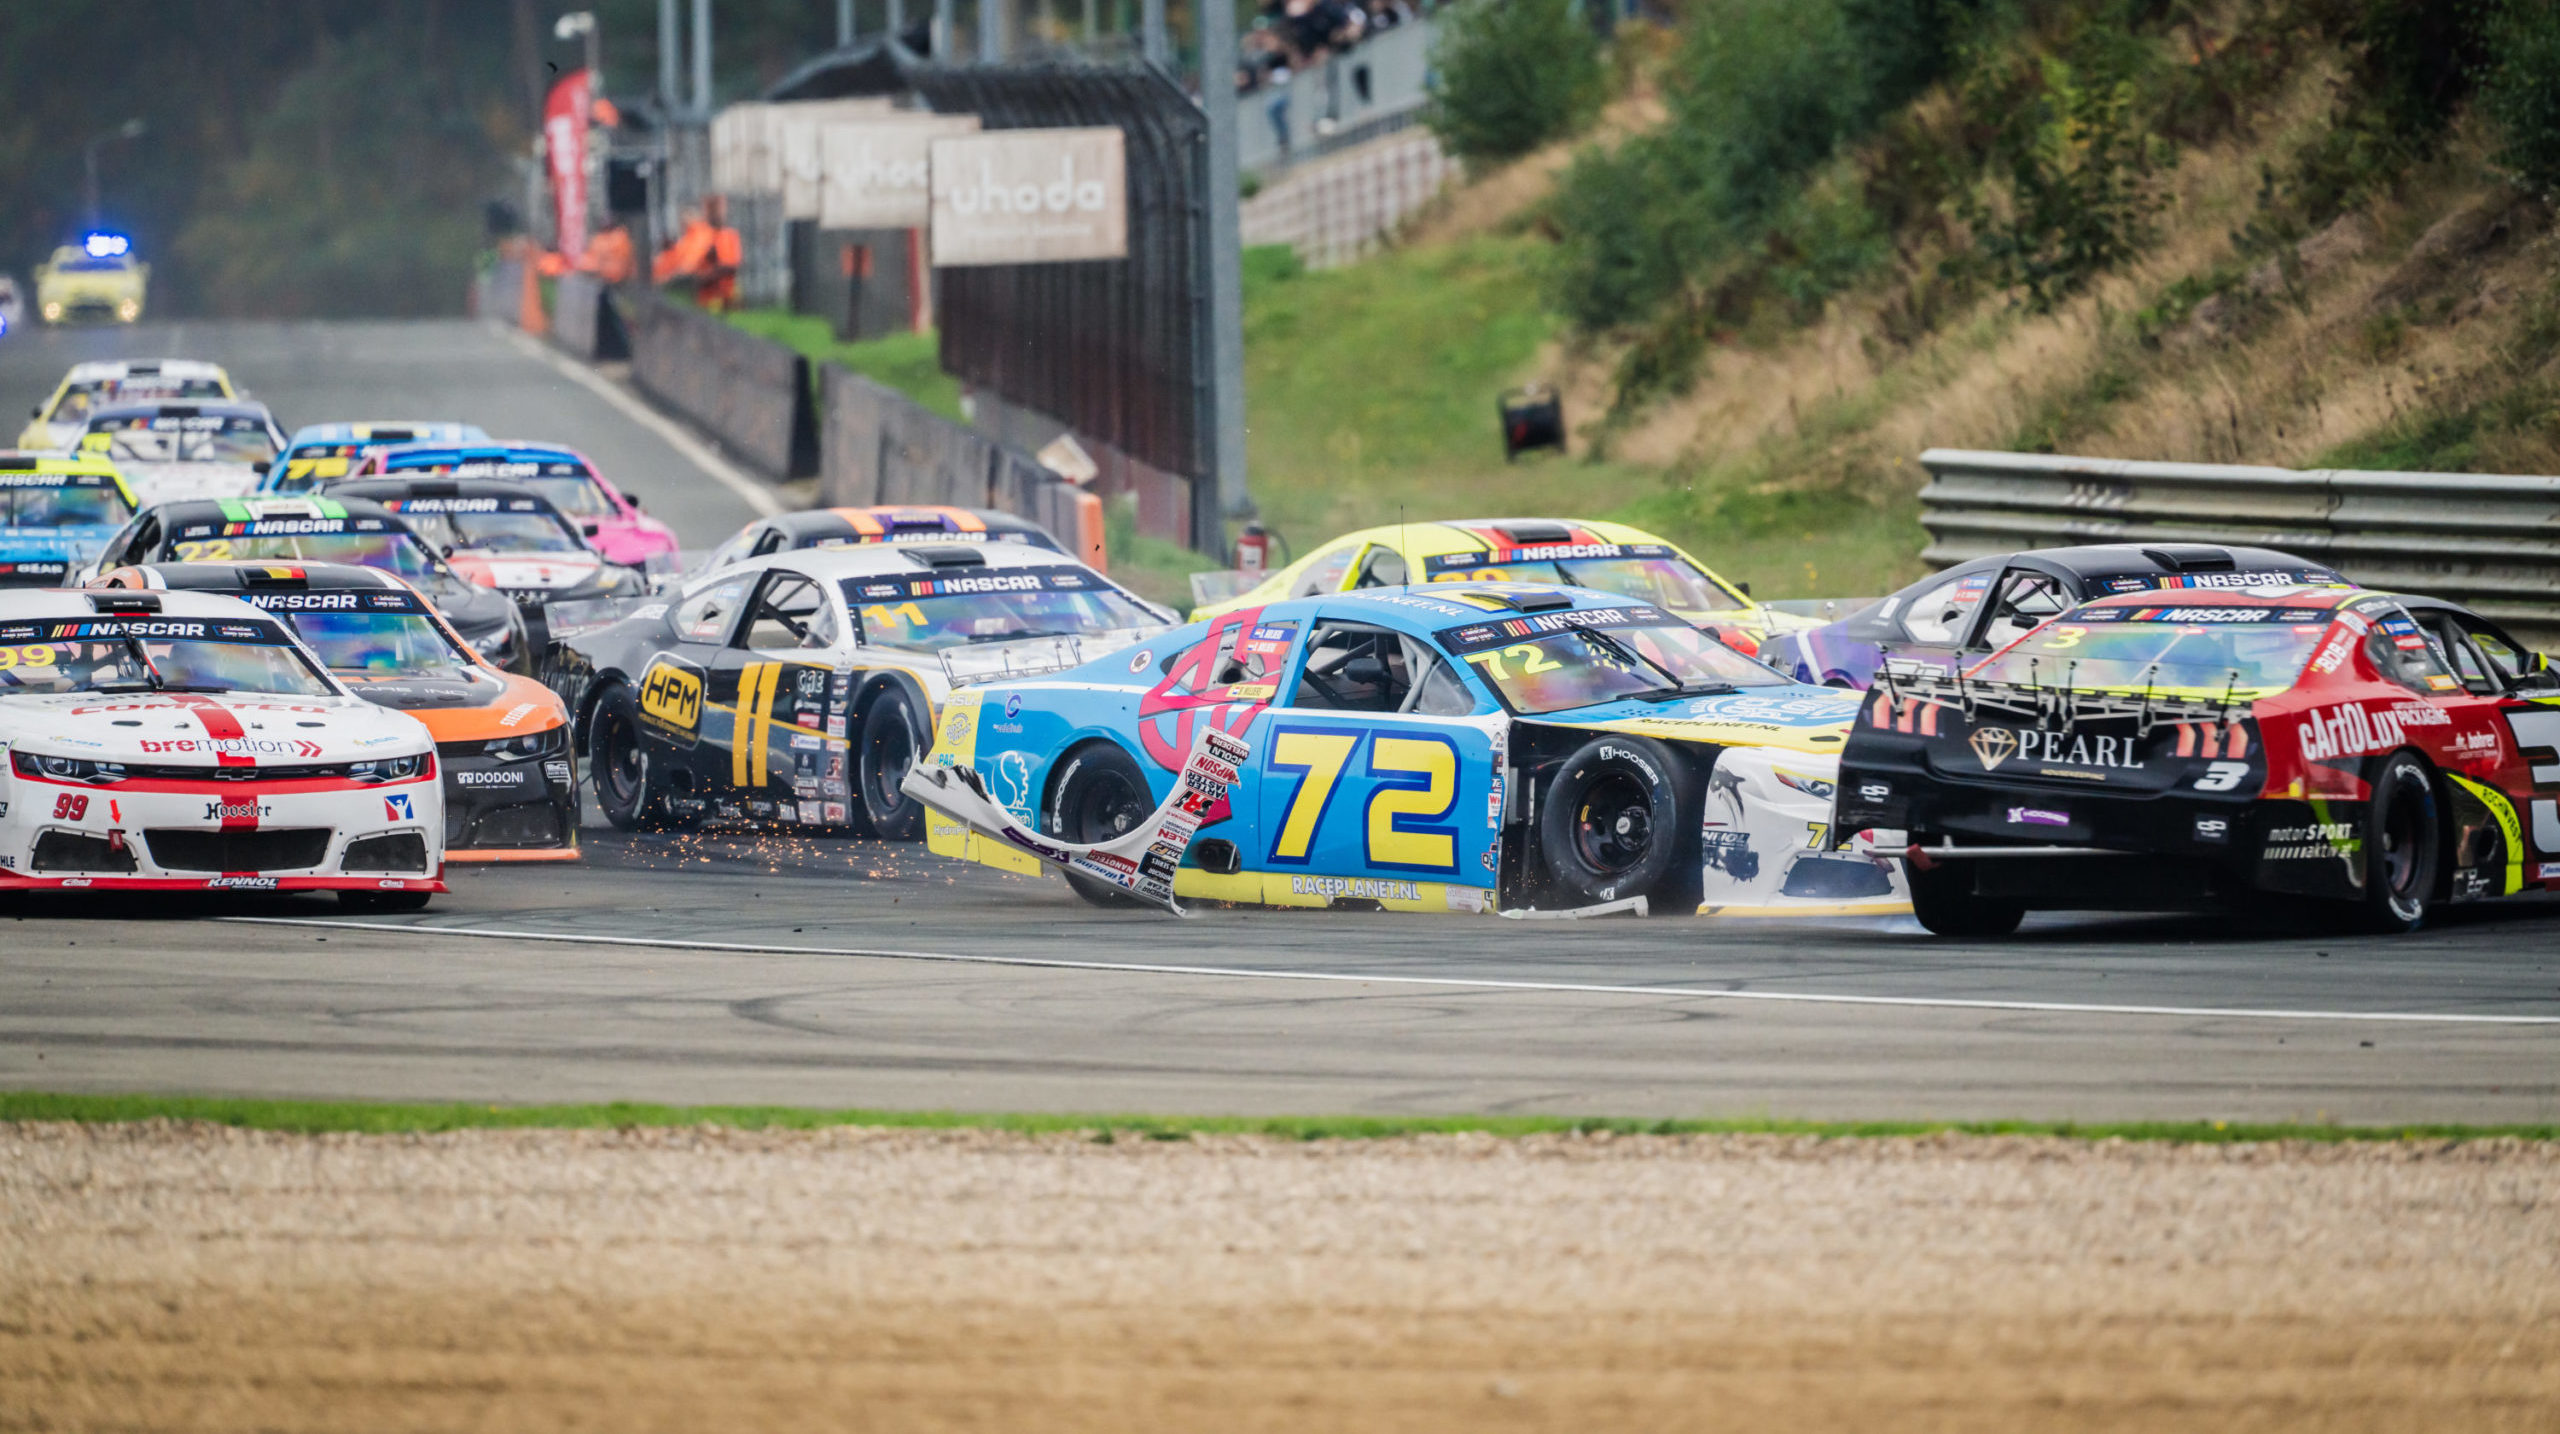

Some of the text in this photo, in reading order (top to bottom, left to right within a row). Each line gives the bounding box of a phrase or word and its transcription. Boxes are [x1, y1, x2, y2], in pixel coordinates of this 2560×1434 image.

[834, 138, 928, 188] uho
[950, 154, 1105, 214] uhoda
[0, 474, 67, 486] ASCAR
[253, 519, 344, 534] NASCAR
[174, 539, 233, 561] 22
[1523, 544, 1621, 560] NASCAR
[943, 575, 1042, 594] NASCAR
[2194, 573, 2295, 588] NASCAR
[250, 594, 357, 609] NASCAR
[862, 602, 928, 628] 11
[1536, 608, 1629, 631] NASCAR
[2163, 609, 2270, 622] NASCAR
[90, 623, 205, 637] NASCAR
[2043, 626, 2089, 648] 3
[1464, 645, 1563, 681] 72
[646, 671, 698, 720] HPM
[732, 661, 783, 787] 11
[141, 738, 297, 753] bremotion
[2016, 730, 2144, 769] PEARL
[476, 772, 524, 783] DODONI
[1195, 756, 1239, 782] MPSON
[1612, 748, 1660, 786] HOOSIER
[2194, 763, 2250, 791] 3
[53, 793, 89, 821] 99
[203, 801, 272, 820] Hoosier
[1266, 724, 1462, 876] 72
[1807, 821, 1853, 851] 7
[207, 877, 279, 889] KENNOL
[1292, 876, 1421, 900] RACEPLANET.NL
